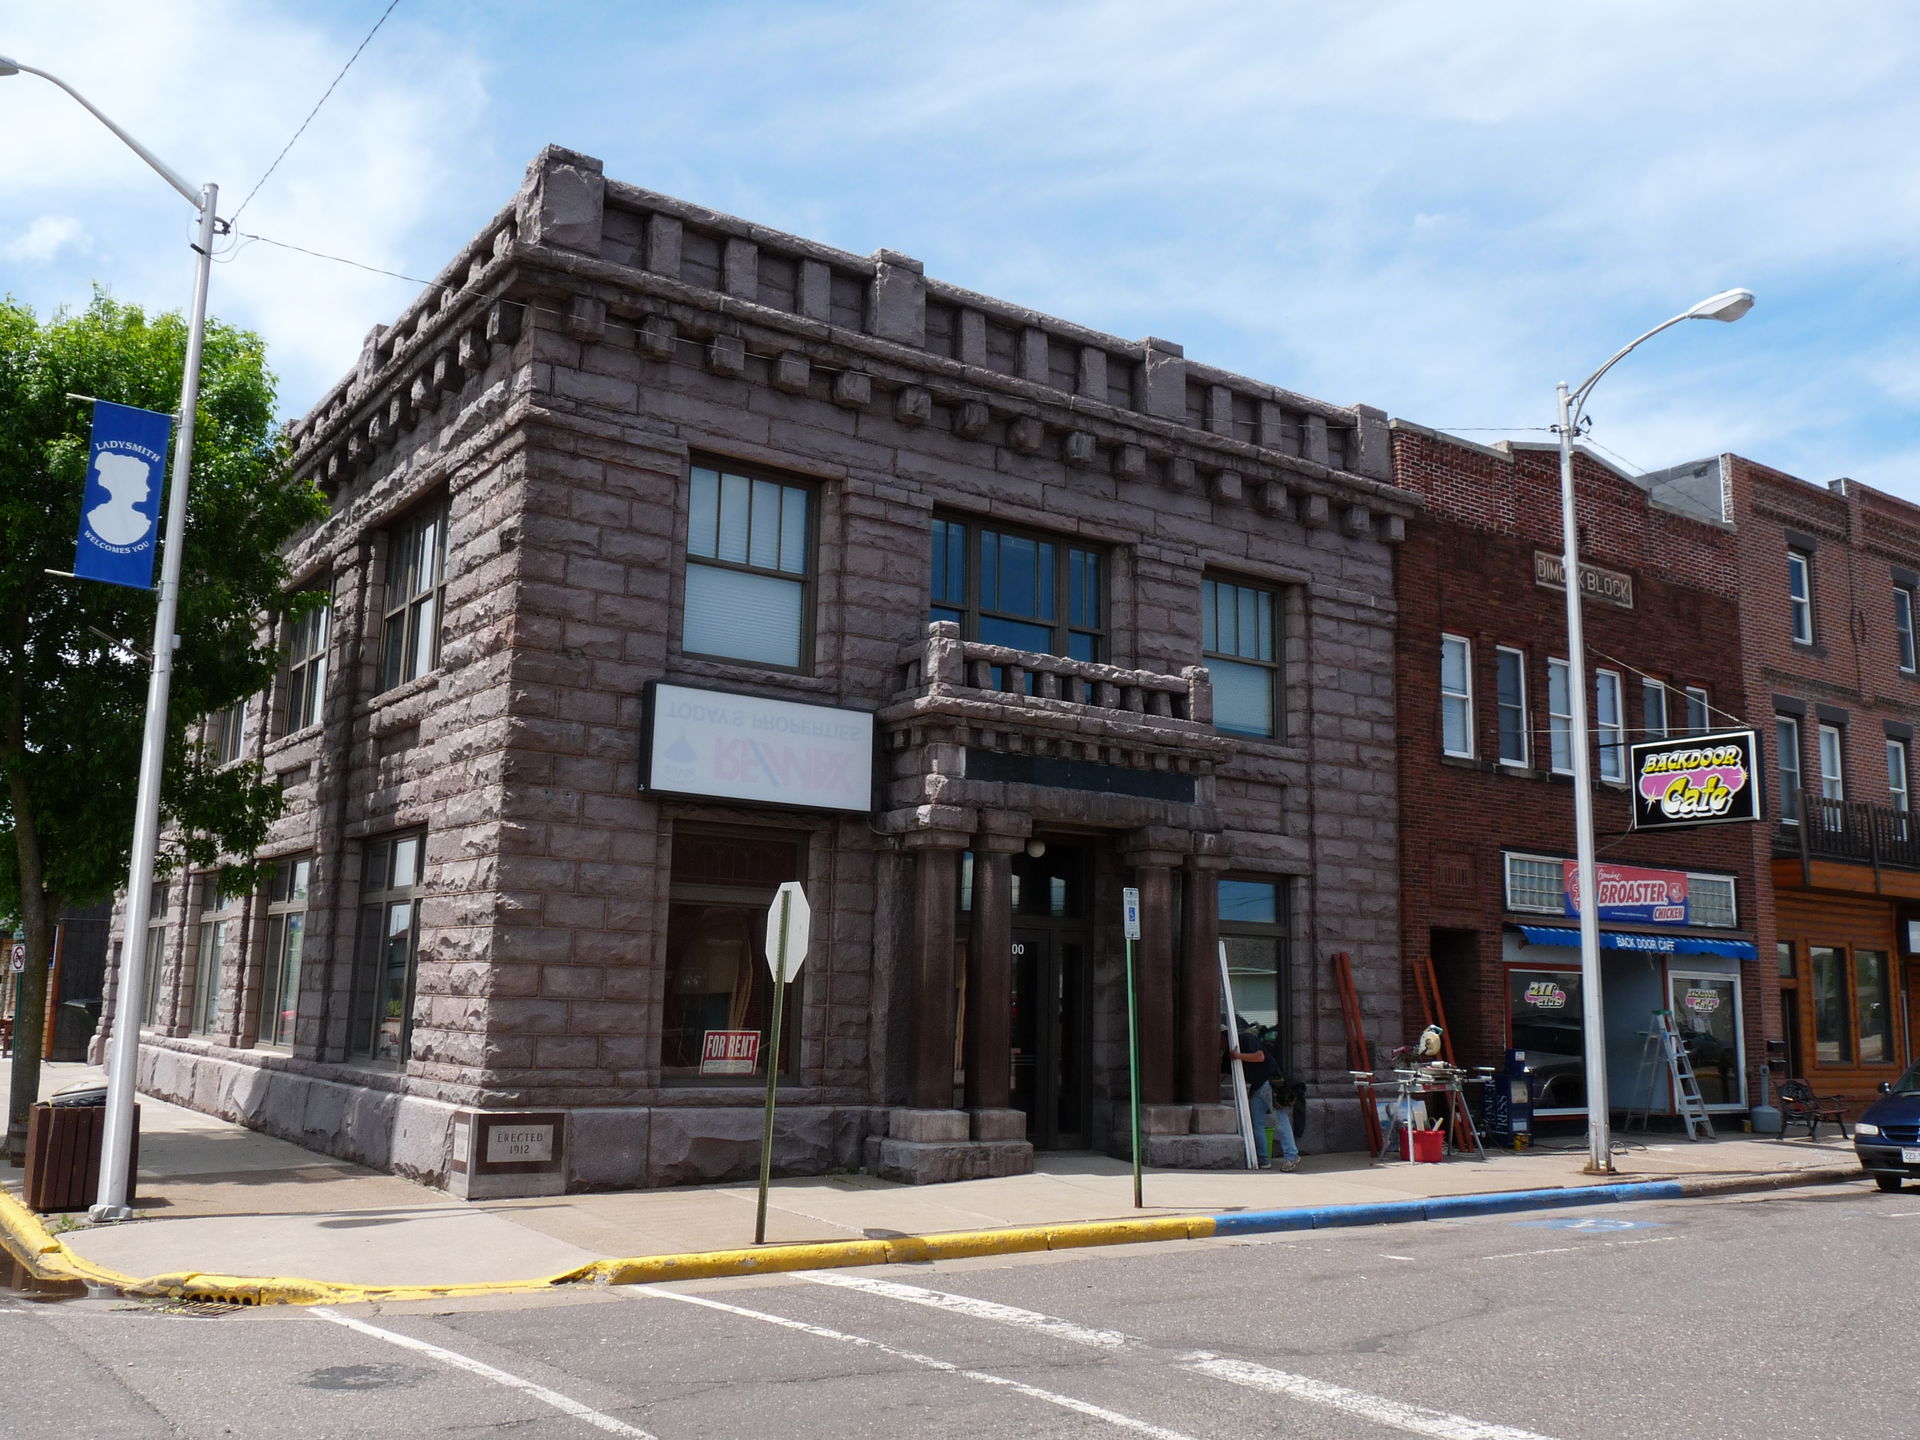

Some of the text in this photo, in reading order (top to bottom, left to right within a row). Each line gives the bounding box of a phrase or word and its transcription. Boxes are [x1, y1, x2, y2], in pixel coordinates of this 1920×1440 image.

[95, 440, 160, 462] LADYSMITH
[84, 530, 150, 554] WELCOMES YOU
[1537, 558, 1629, 600] DIMOK BLOCK
[1643, 746, 1740, 774] BACKDOOR
[1662, 775, 1731, 816] Cafe
[1654, 906, 1683, 920] CHICKEN
[1616, 937, 1675, 951] BACK DOOR CAFE
[705, 1035, 755, 1058] FOR RENT
[497, 1132, 544, 1143] ERECTED
[509, 1145, 530, 1154] 1912
